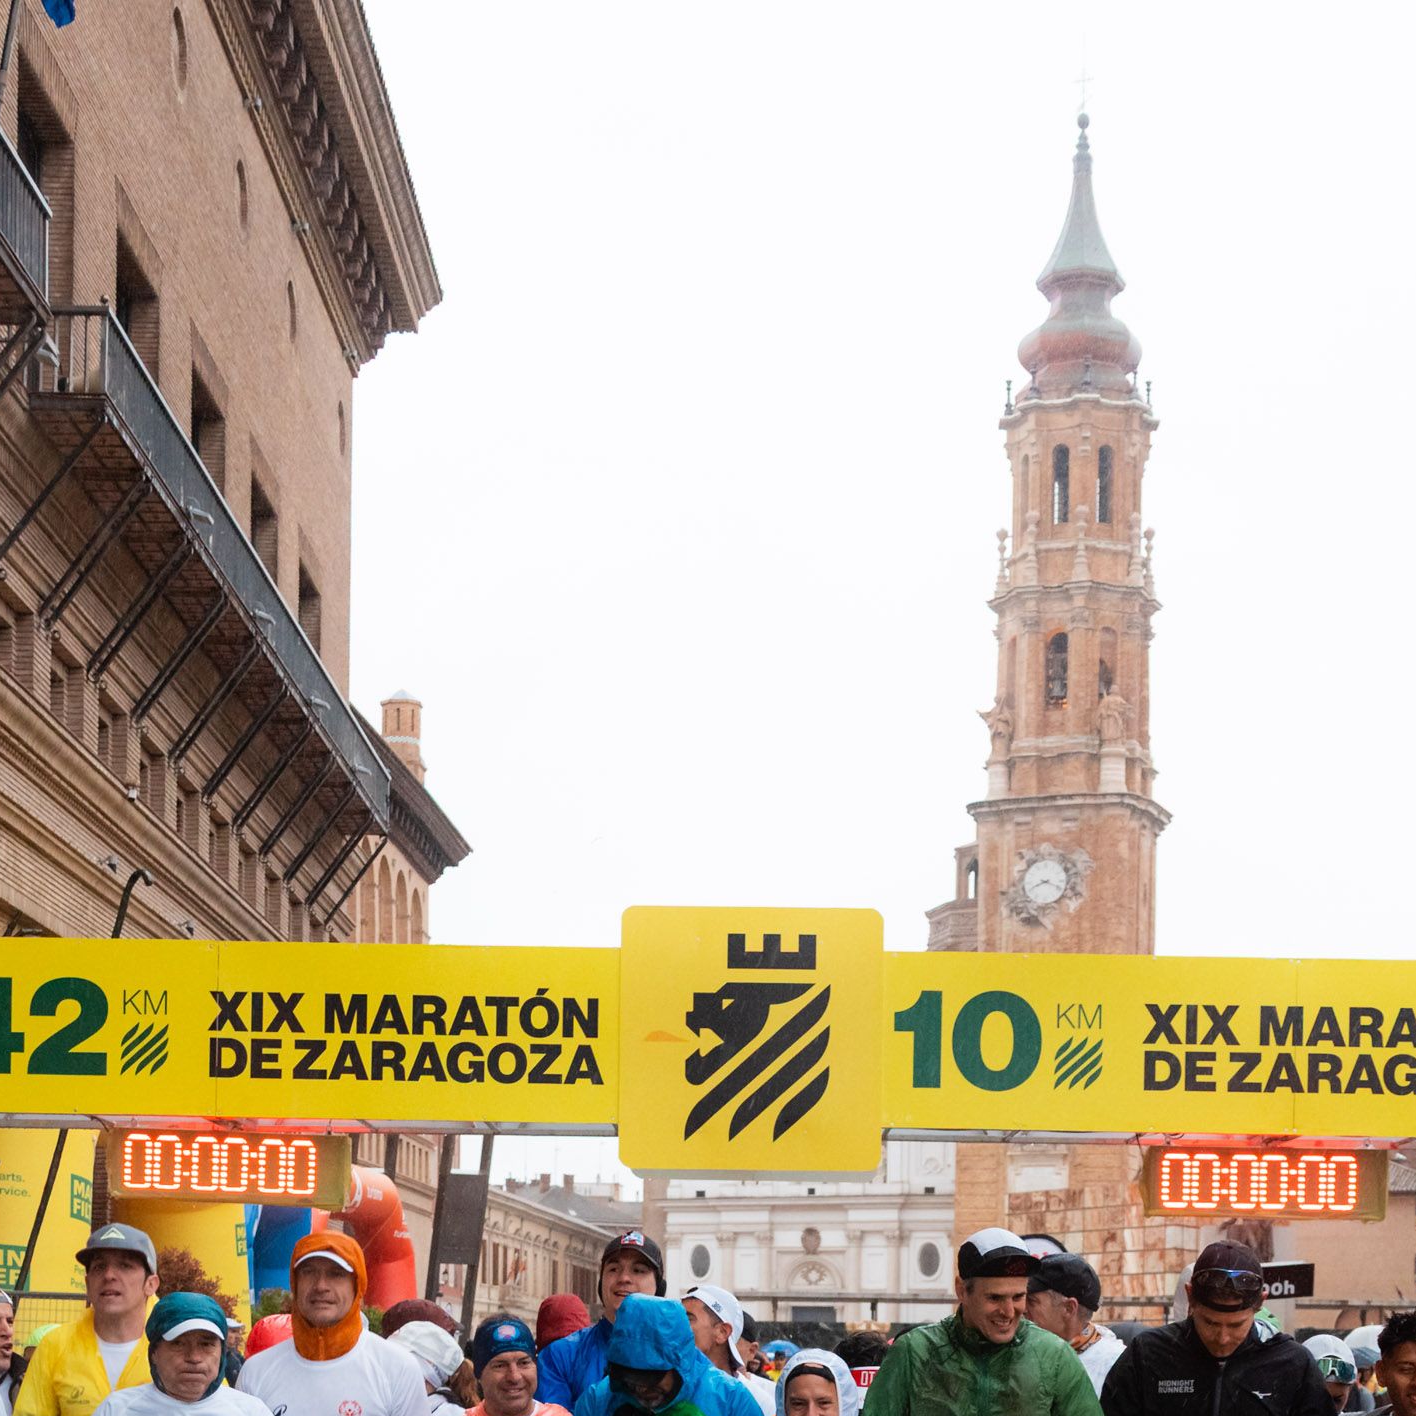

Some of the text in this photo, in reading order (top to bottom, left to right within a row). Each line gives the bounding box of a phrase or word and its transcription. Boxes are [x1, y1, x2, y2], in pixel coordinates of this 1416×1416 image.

[123, 990, 169, 1016] KM
[209, 987, 600, 1039] XIX MARATÓN
[1143, 1004, 1241, 1047] XIX
[209, 1037, 605, 1086] DE ZARAGOZA
[894, 990, 1103, 1092] 10 KM
[1143, 1051, 1216, 1092] DE
[123, 1133, 317, 1195] 00:00:00
[1160, 1152, 1358, 1211] 00:00:00
[1158, 1379, 1195, 1387] MIDNIGHT
[1158, 1386, 1195, 1394] RUNNERS
